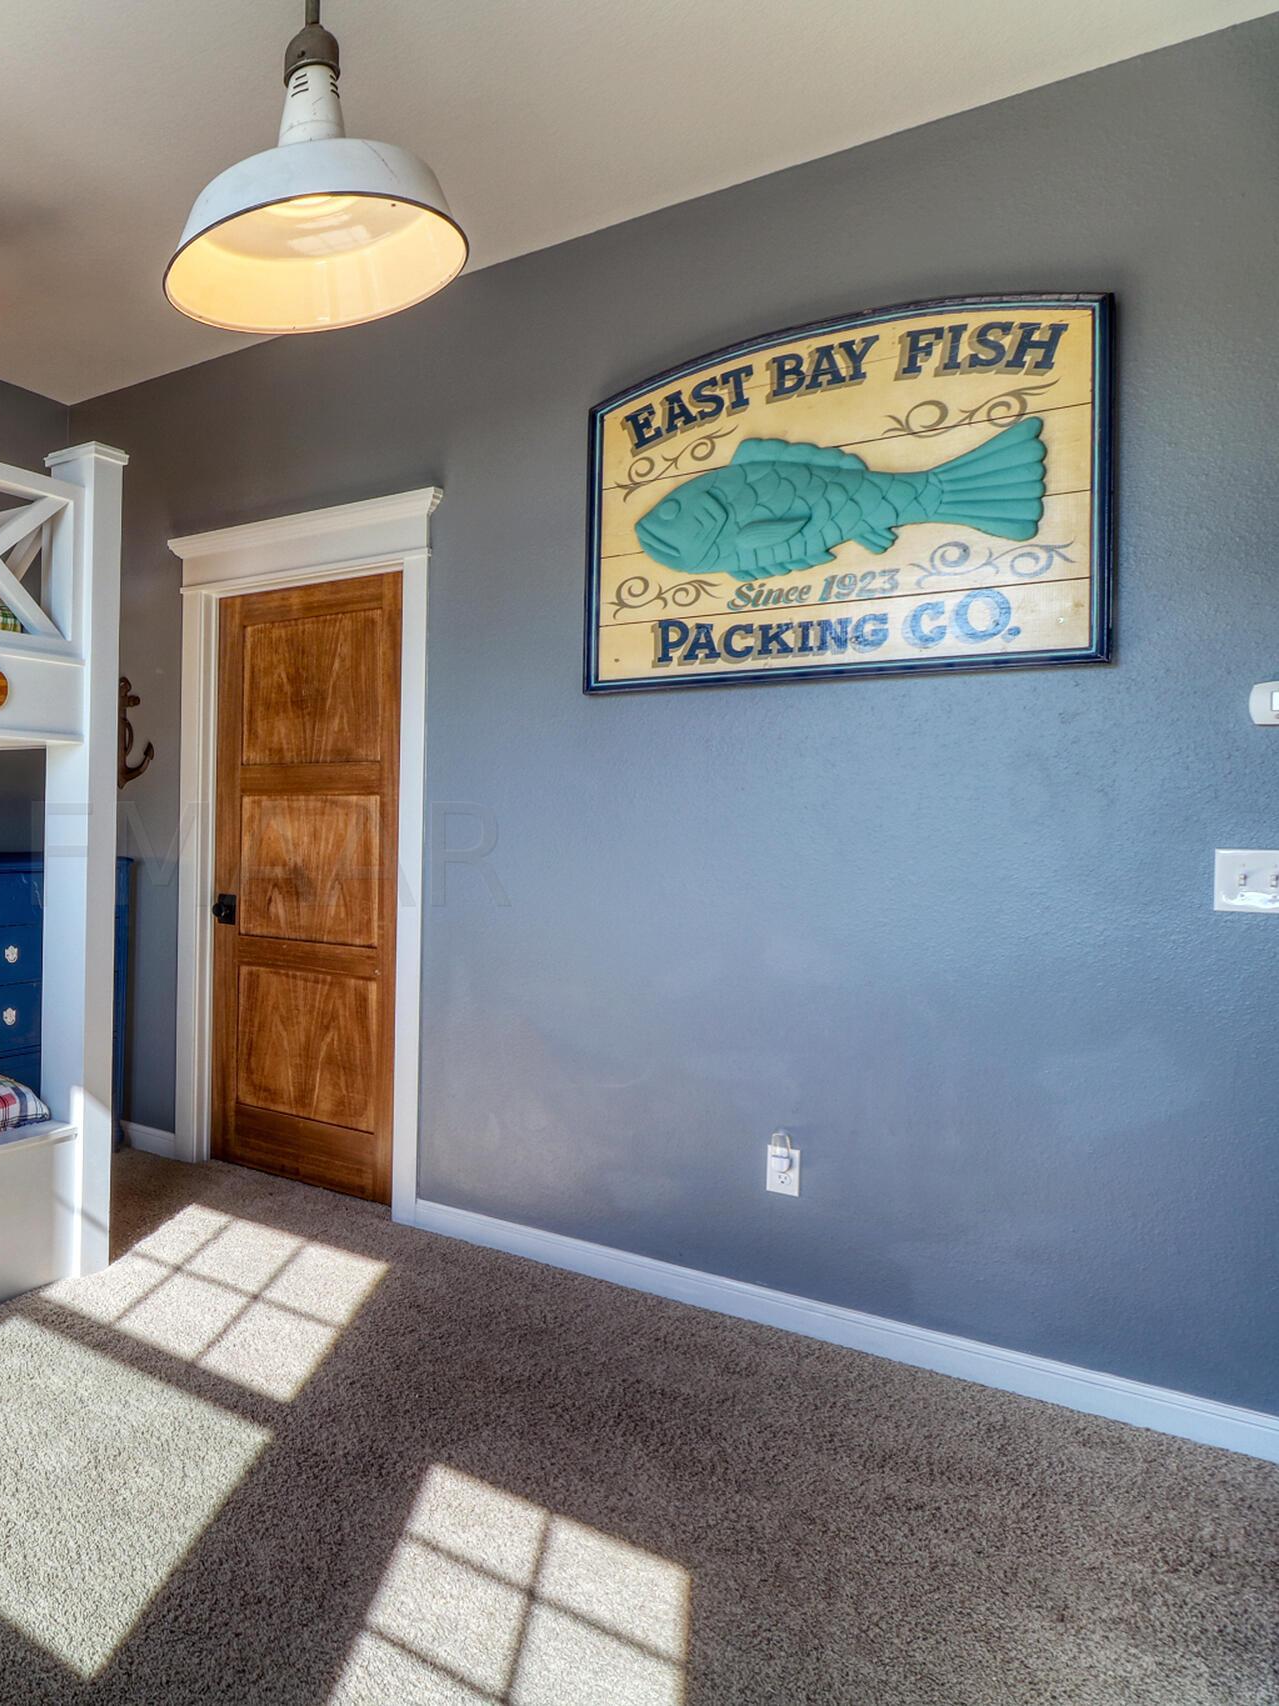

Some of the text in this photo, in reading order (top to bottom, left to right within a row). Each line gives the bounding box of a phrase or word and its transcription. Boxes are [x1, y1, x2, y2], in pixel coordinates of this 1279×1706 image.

[622, 321, 1069, 456] EAST BAY FISH
[651, 588, 1022, 668] PACKING CO.
[727, 568, 901, 611] Since 1923
